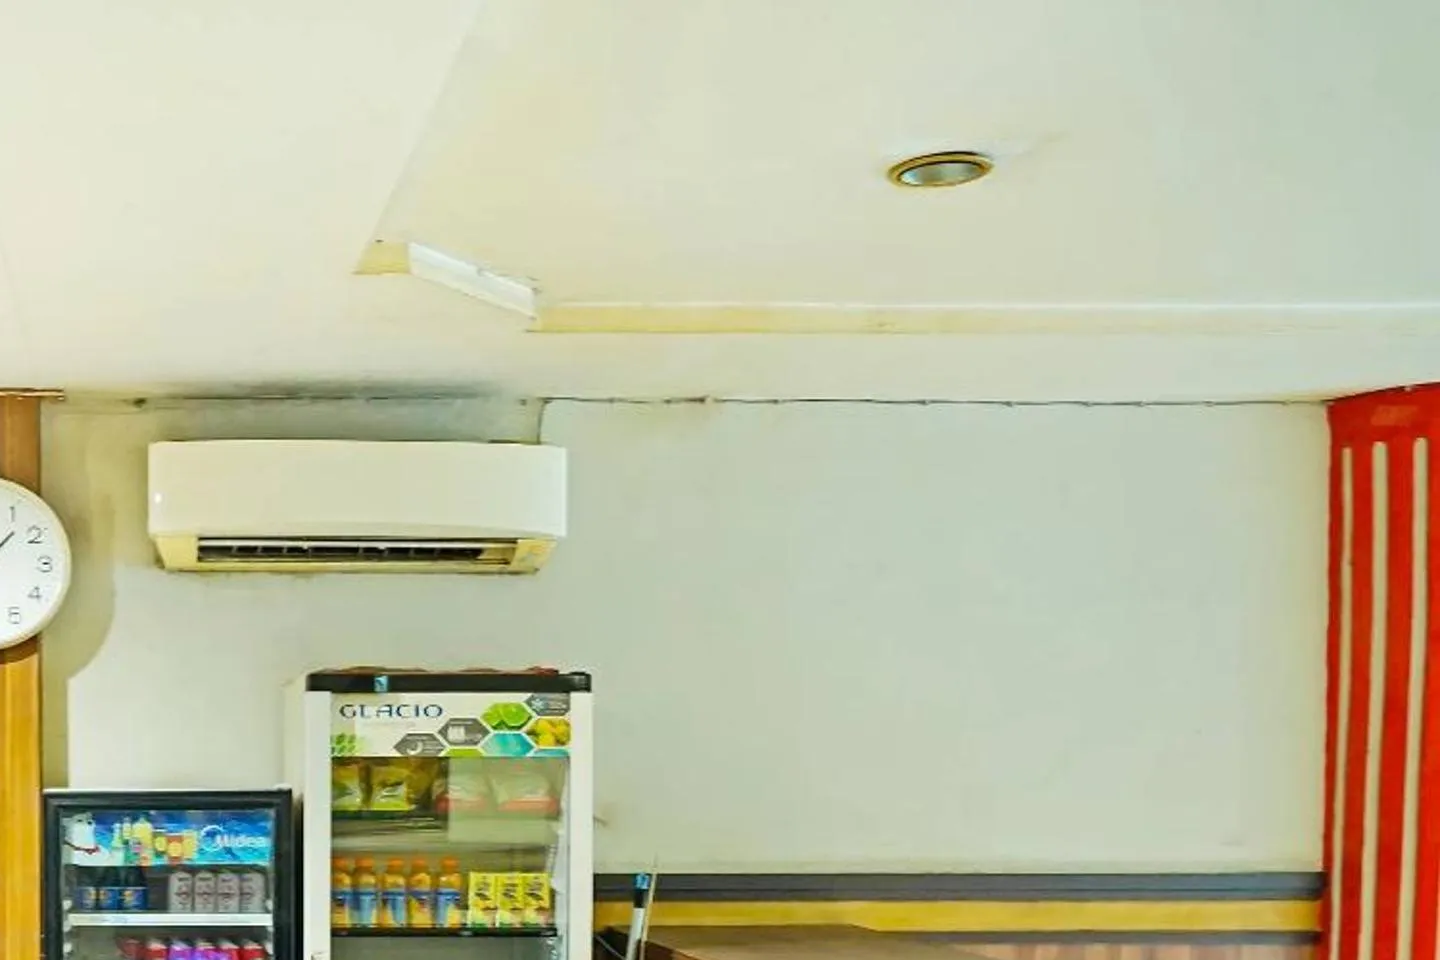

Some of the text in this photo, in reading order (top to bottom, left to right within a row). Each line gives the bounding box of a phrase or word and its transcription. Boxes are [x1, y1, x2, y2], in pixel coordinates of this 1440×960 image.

[10, 506, 16, 522] 1
[26, 526, 43, 544] 2
[37, 555, 53, 573] 3
[27, 586, 42, 600] 4
[8, 606, 21, 625] 5
[339, 704, 443, 719] GLACIO
